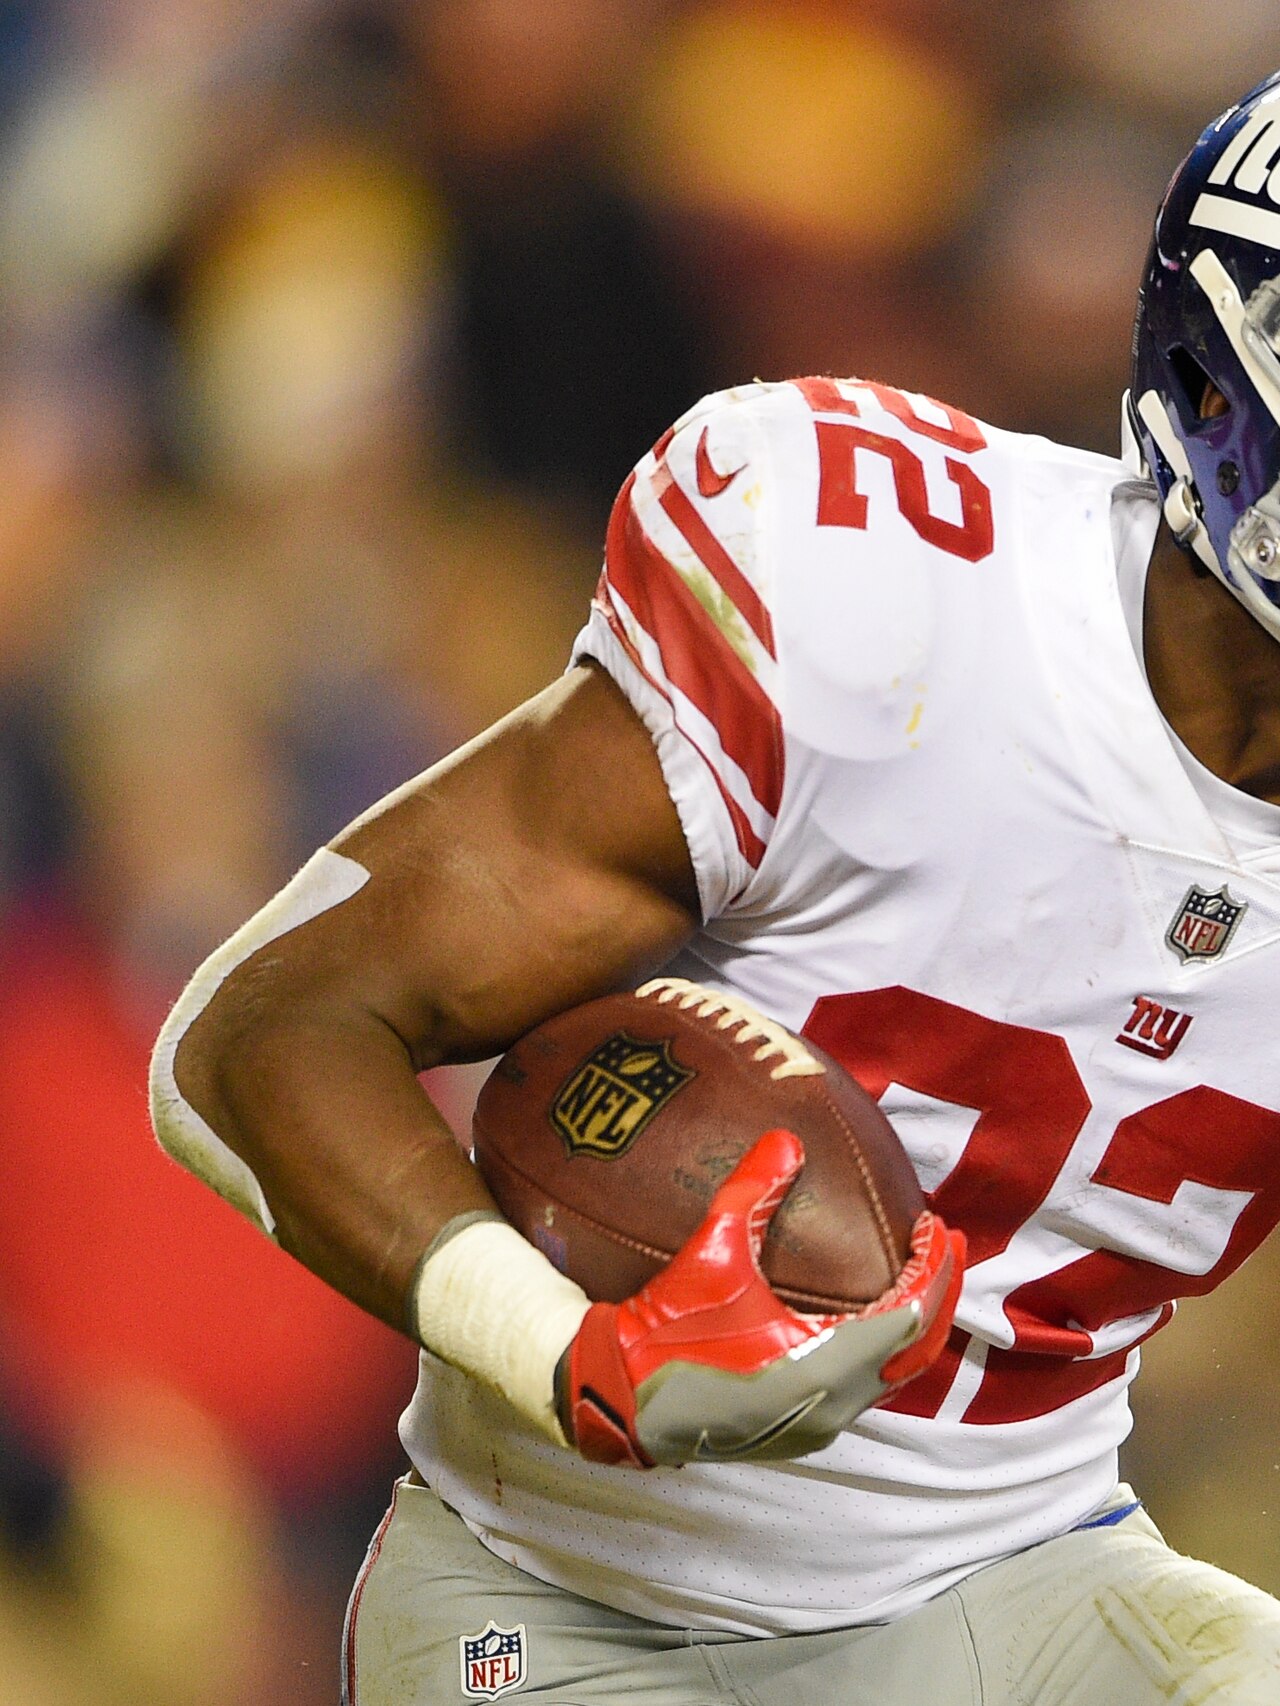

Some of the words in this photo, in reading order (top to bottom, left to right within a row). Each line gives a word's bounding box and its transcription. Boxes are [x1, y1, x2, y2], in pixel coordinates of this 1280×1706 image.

[1175, 915, 1221, 952] NFL
[560, 1069, 640, 1143] NFL
[470, 1656, 516, 1689] NFL
